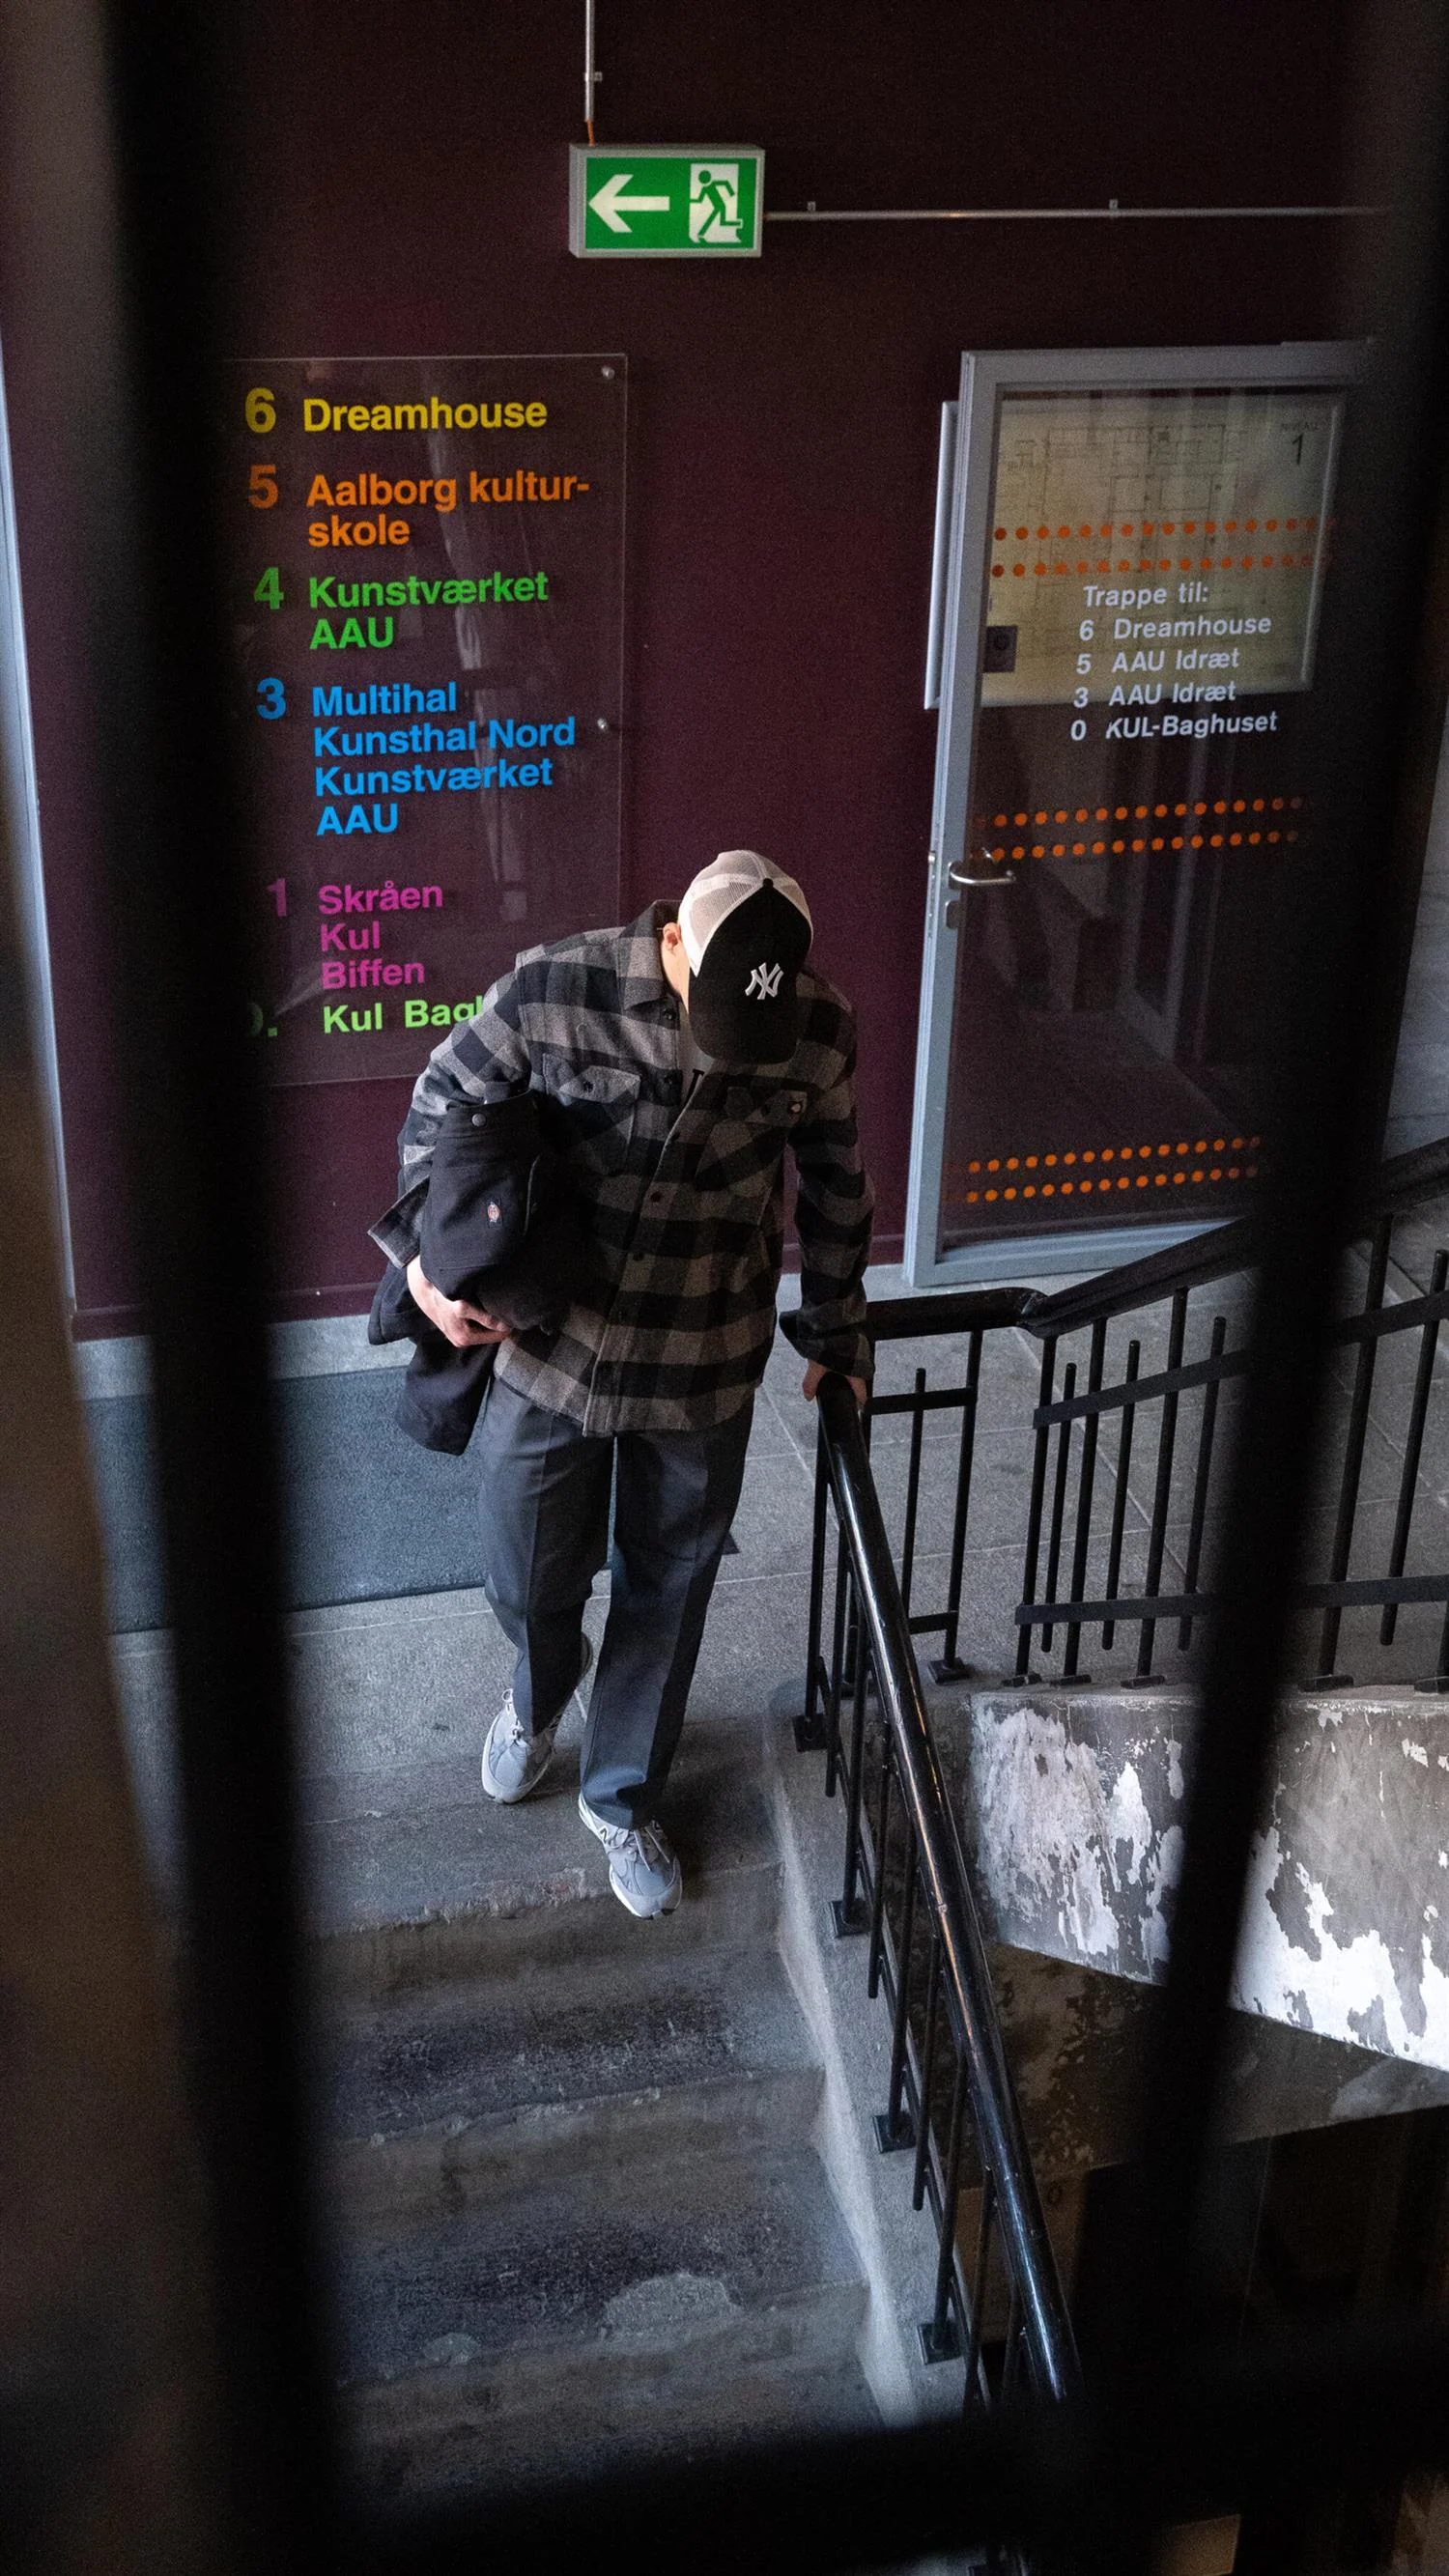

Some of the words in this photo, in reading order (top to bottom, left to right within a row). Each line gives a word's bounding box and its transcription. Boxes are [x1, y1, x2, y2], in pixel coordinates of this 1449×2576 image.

[244, 387, 276, 433] 6
[302, 396, 548, 432] Dreamhouse
[1292, 433, 1304, 467] 1
[248, 464, 278, 509] 5
[305, 473, 457, 512] Aalborg
[469, 469, 590, 503] kultur-
[307, 513, 411, 548] skole
[253, 566, 285, 610] 4
[308, 572, 549, 609] Kunstværket
[1083, 584, 1167, 609] Trappe
[1179, 580, 1209, 604] til:
[309, 616, 394, 650] AAU
[1079, 619, 1094, 641] 6
[1113, 615, 1272, 639] Dreamhouse
[1076, 653, 1092, 675] 5
[1111, 650, 1166, 673] AAU
[1175, 647, 1240, 670] Idræt
[257, 677, 287, 721] 3
[312, 681, 457, 719] Multihal
[1073, 687, 1090, 709] 3
[1108, 683, 1163, 706] AAU
[1172, 680, 1237, 704] Idræt
[314, 721, 477, 757] Kunsthal
[488, 716, 576, 750] Nord
[1070, 719, 1087, 741] 0
[1105, 710, 1278, 739] KUL-Baghuset
[315, 758, 554, 797] Kunstværket
[316, 803, 399, 836] AAU
[269, 878, 288, 917] 1
[318, 880, 443, 915] Skråen
[320, 920, 381, 952] Kul
[321, 958, 425, 990] Biffen
[745, 962, 784, 1000] NY
[323, 1005, 383, 1033] Kul
